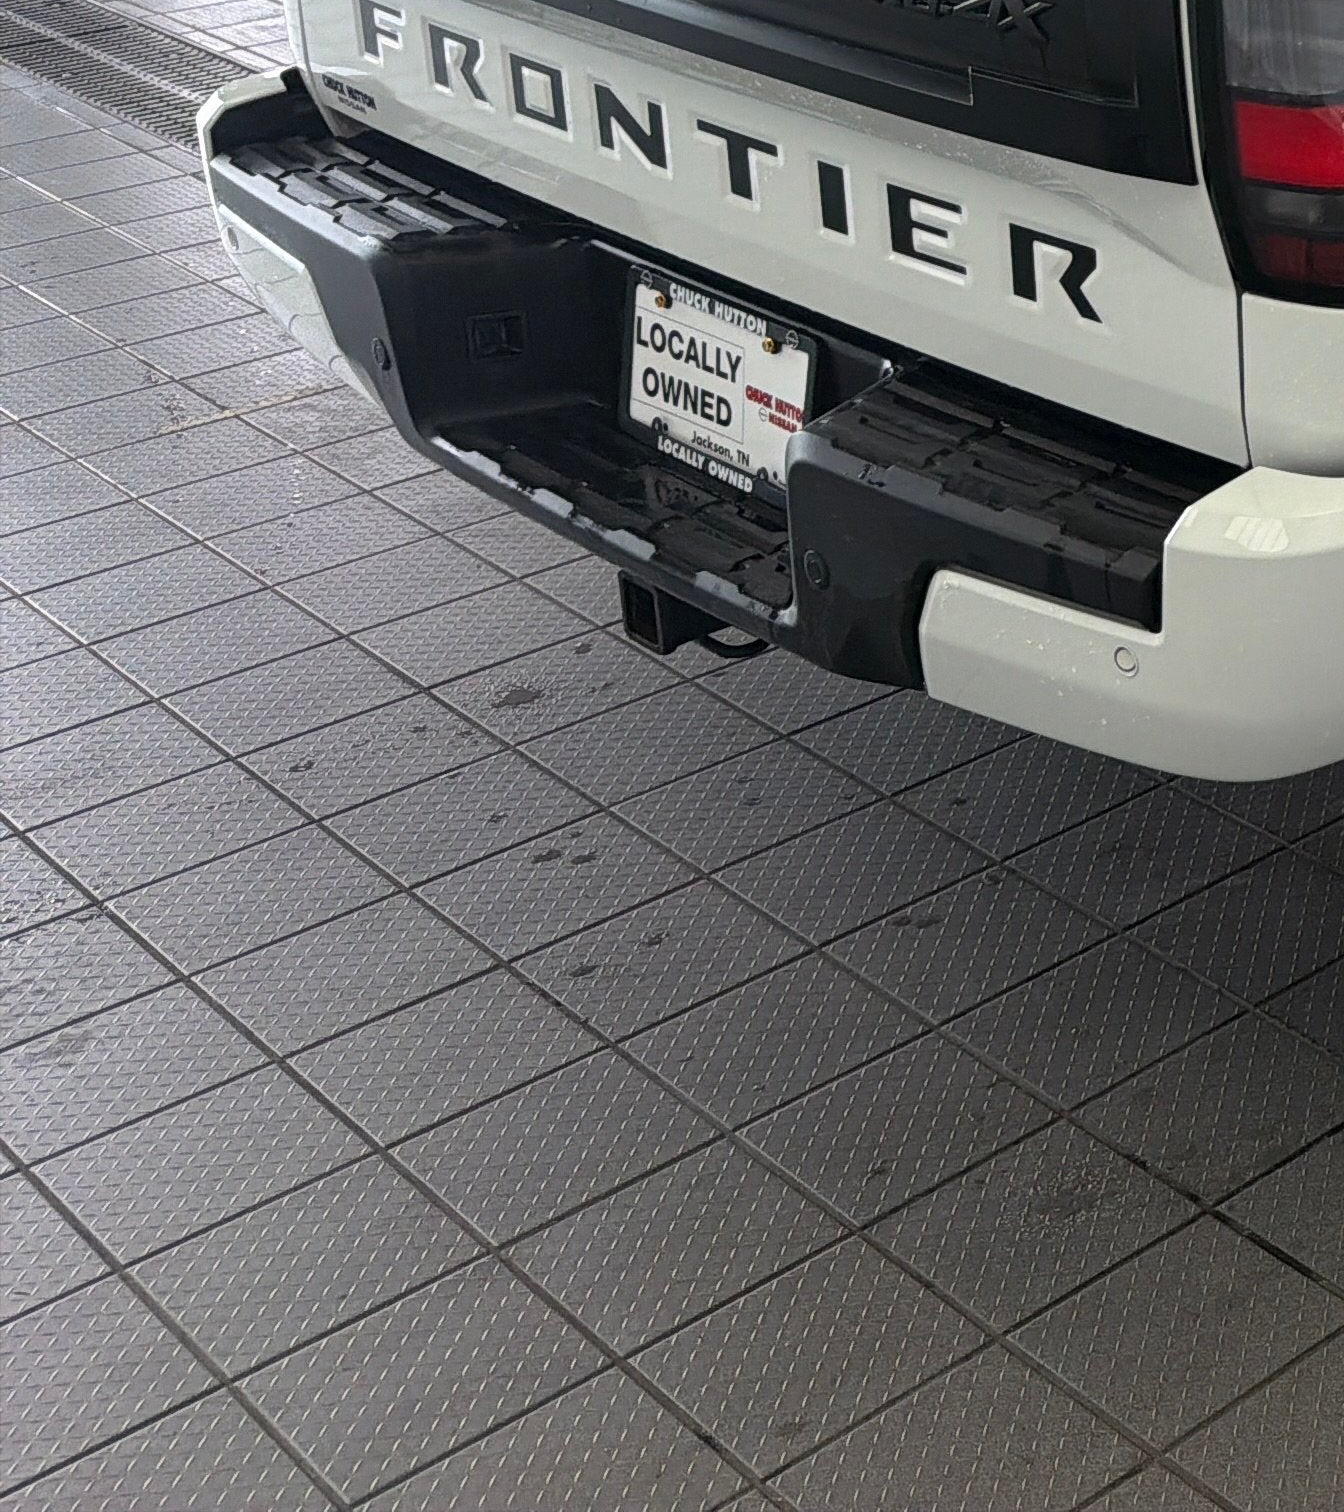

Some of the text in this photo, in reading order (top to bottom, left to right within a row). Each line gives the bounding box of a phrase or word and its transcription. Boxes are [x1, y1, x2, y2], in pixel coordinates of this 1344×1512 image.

[669, 283, 768, 337] CHUCK HUTTON
[636, 316, 742, 384] LOCALLY
[642, 367, 732, 427] OWNED
[657, 435, 753, 493] LOCALLY OWNED
[691, 430, 750, 467] Jackson, TN
